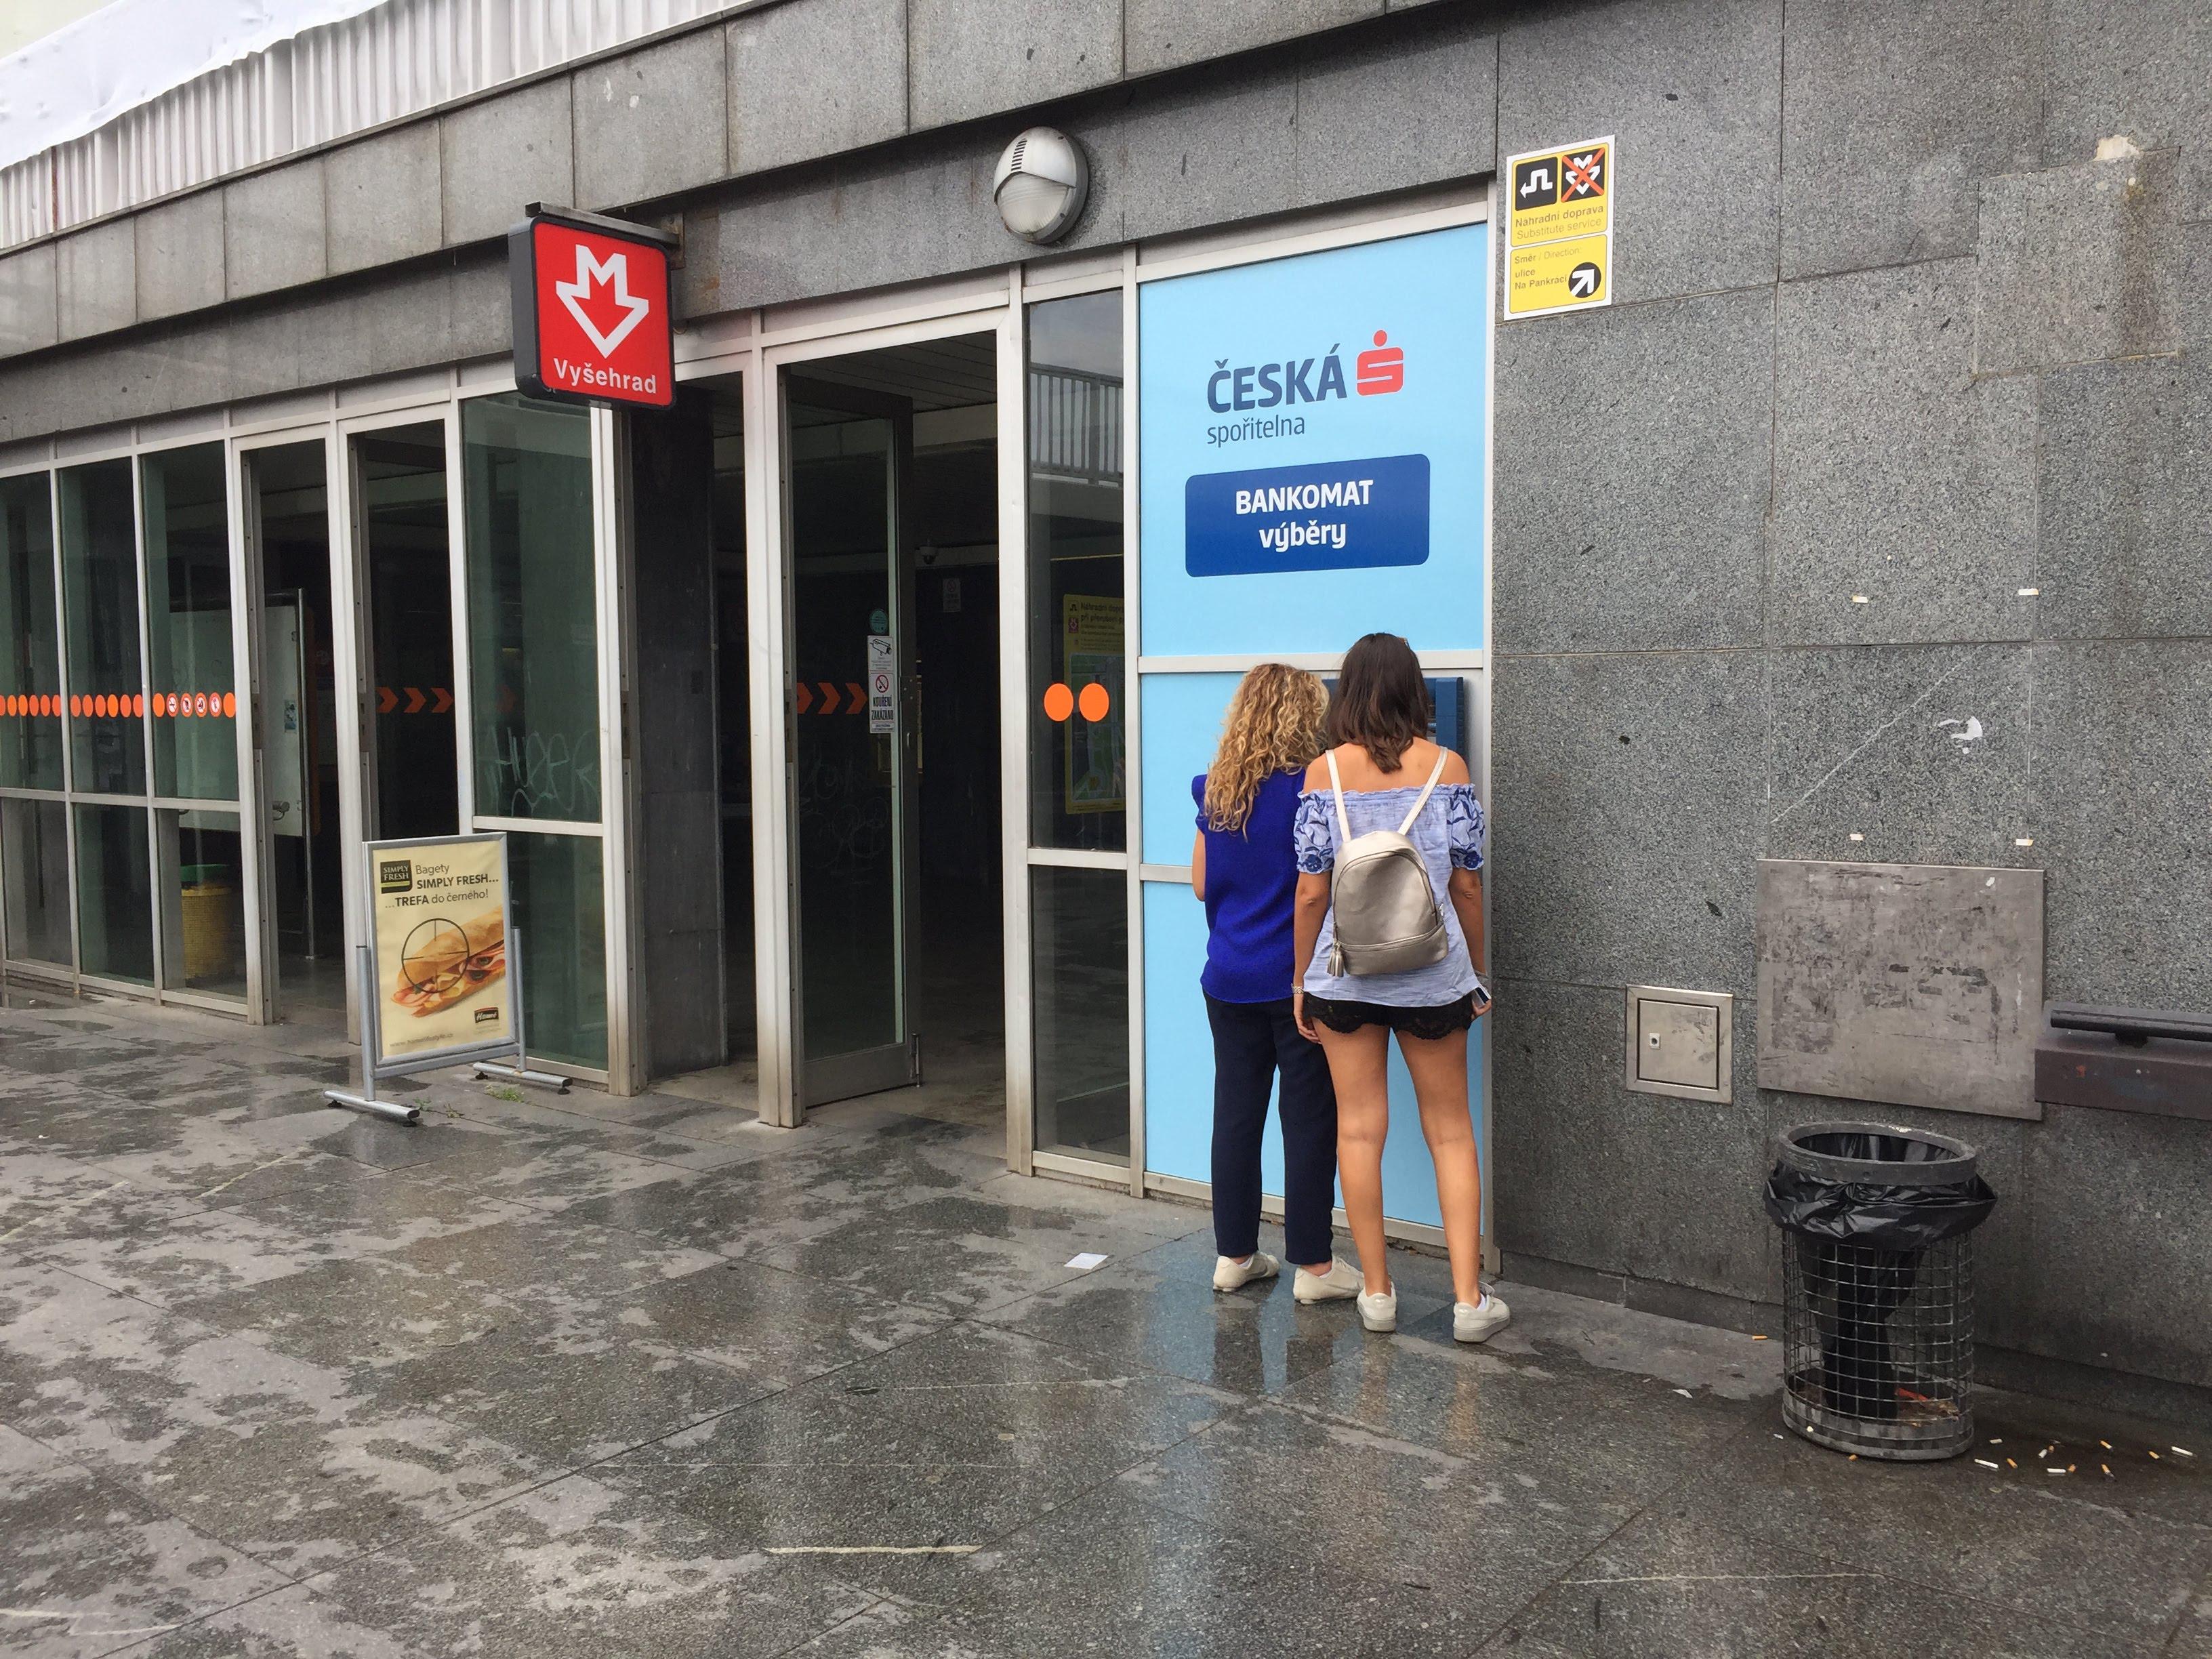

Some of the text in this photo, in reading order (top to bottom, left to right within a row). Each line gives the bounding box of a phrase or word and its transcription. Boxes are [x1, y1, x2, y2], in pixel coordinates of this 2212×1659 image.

[1563, 205, 1603, 220] doprava
[1517, 218, 1601, 240] Substitute service
[1515, 268, 1536, 279] ulice
[1515, 281, 1526, 290] Na
[553, 358, 657, 394] Vyšehrad
[1206, 343, 1347, 413] ČESKÁ
[1206, 414, 1305, 448] spořitelna
[1235, 479, 1374, 514] BANKOMAT
[1258, 519, 1347, 552] výběry
[383, 865, 409, 874] SIMPLY
[384, 872, 409, 881] FRESH
[415, 863, 450, 876] Bagety
[417, 876, 454, 889] SIMPLY
[431, 894, 445, 903] do
